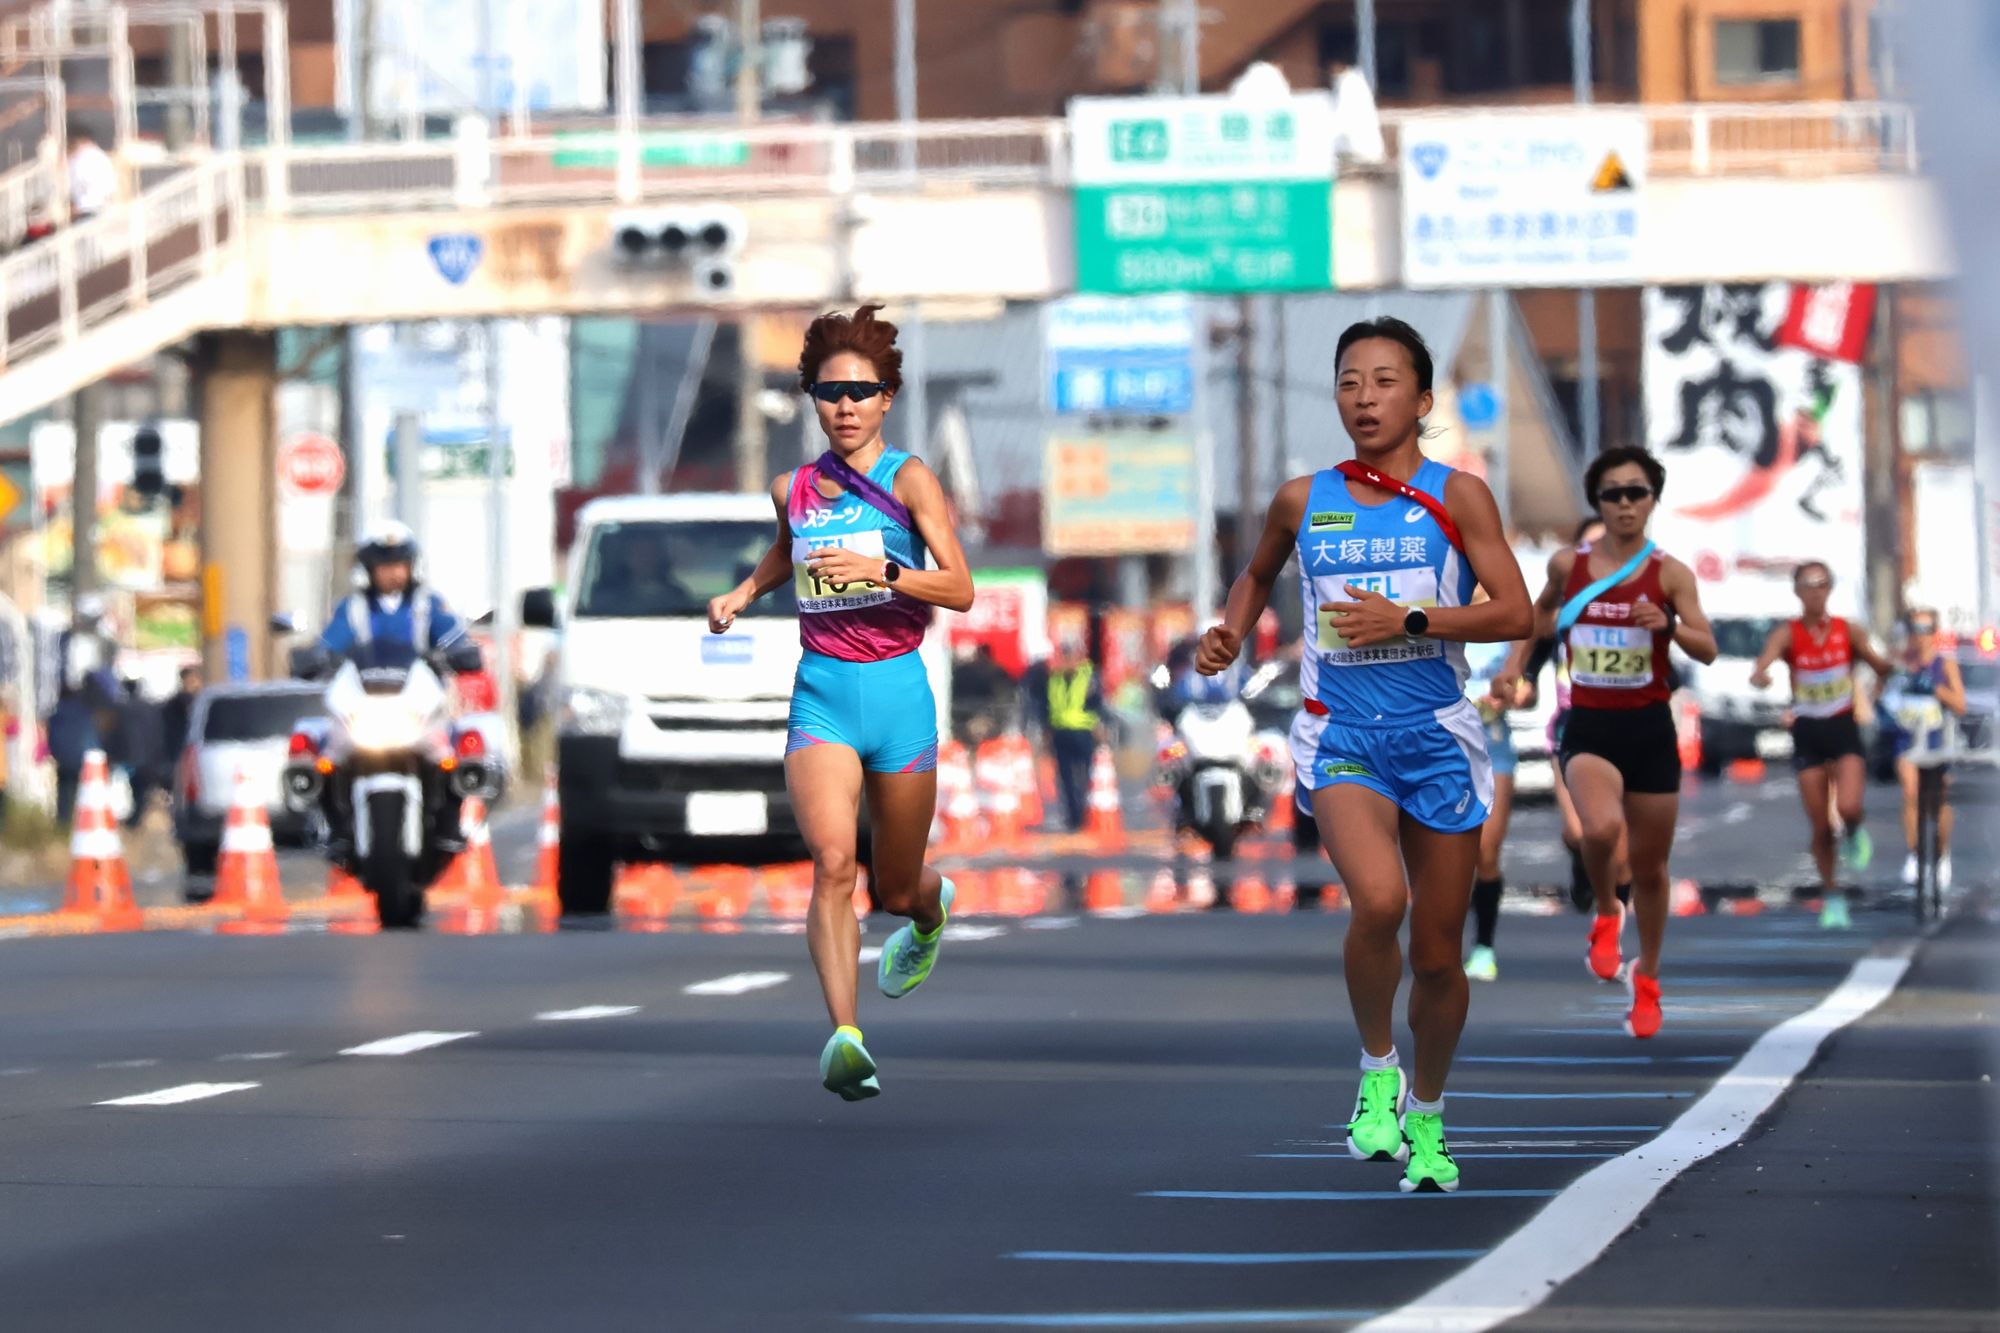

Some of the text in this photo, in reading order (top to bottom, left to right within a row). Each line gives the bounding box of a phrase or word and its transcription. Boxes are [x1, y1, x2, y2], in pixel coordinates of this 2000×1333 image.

[802, 505, 863, 529] スターツ
[1311, 536, 1427, 567] 大塚製薬
[1592, 629, 1627, 647] TEL
